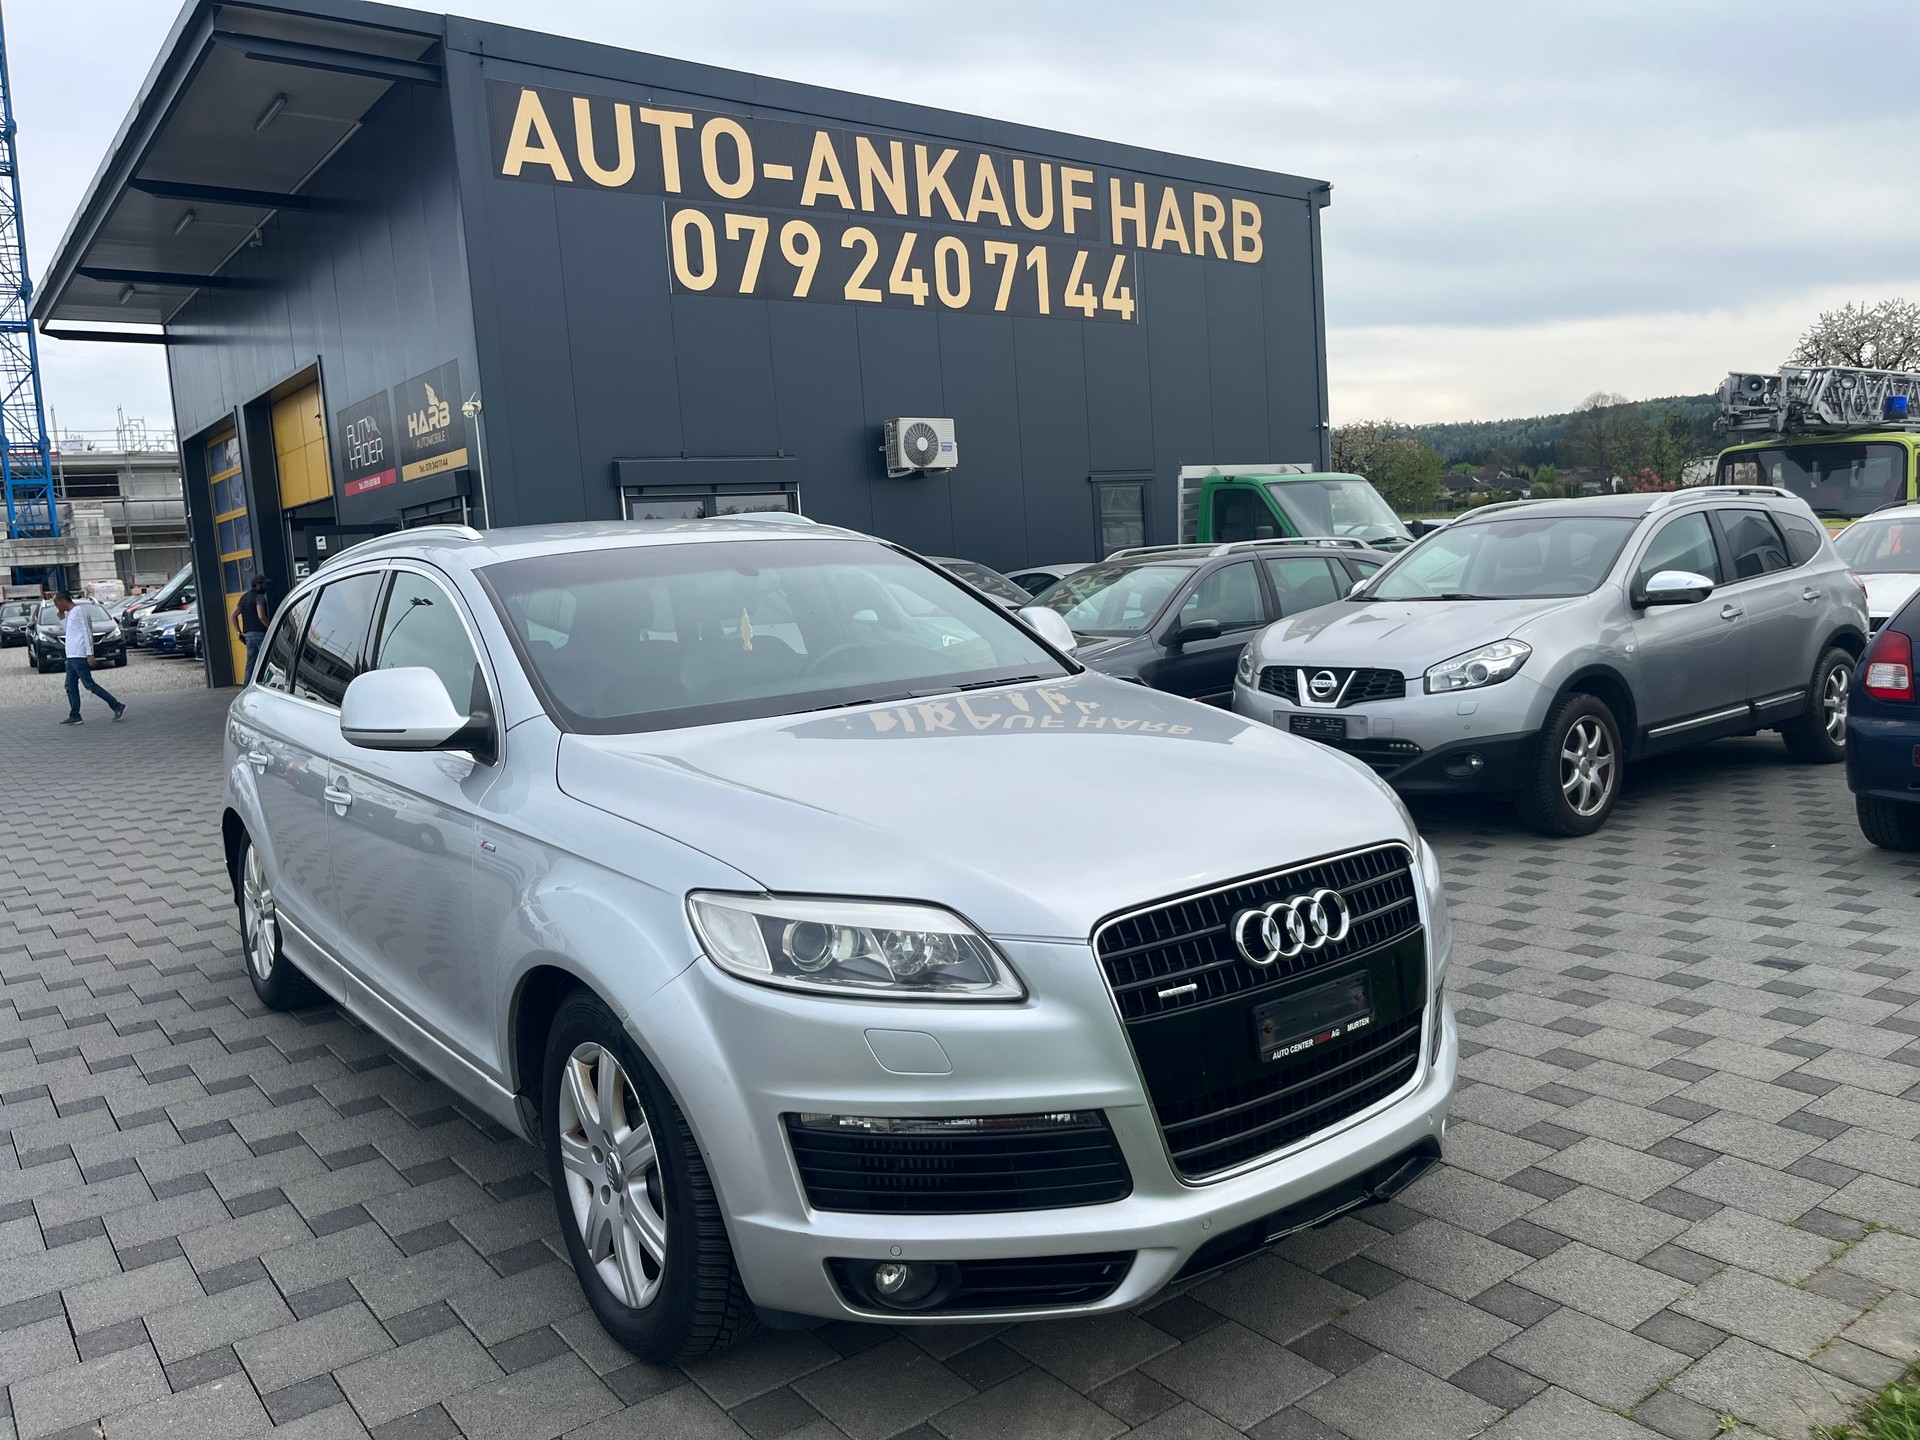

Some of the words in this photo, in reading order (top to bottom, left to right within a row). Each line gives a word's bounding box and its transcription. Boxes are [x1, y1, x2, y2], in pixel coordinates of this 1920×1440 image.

[501, 88, 1095, 233] AUTO-ANKAUF
[1110, 177, 1264, 264] HARB
[671, 208, 822, 299] 079
[843, 226, 970, 309] 240
[407, 401, 450, 438] HARB
[416, 430, 446, 450] AUTOMOBILE
[1272, 1047, 1289, 1060] AUTO
[1290, 1039, 1314, 1054] CENTER
[1331, 1029, 1340, 1039] AG
[1347, 1016, 1370, 1032] MURTEN
